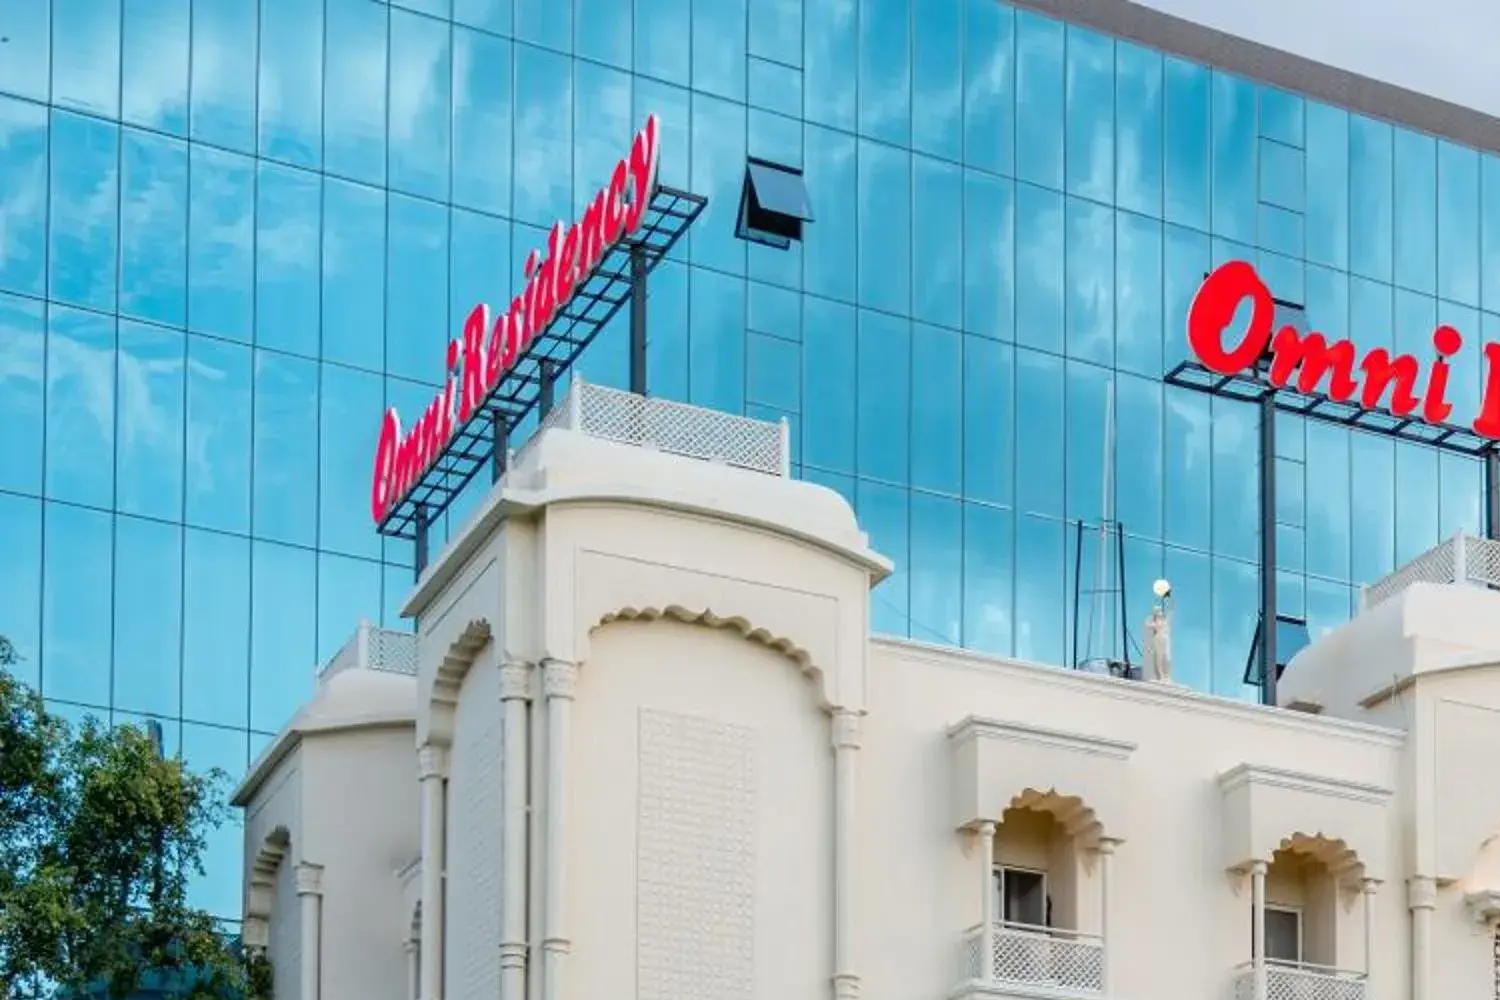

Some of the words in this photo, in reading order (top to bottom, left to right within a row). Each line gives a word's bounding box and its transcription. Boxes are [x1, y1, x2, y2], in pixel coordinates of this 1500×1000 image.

[372, 338, 462, 524] Omni
[459, 113, 660, 422] Residency
[1188, 260, 1462, 423] Omni
